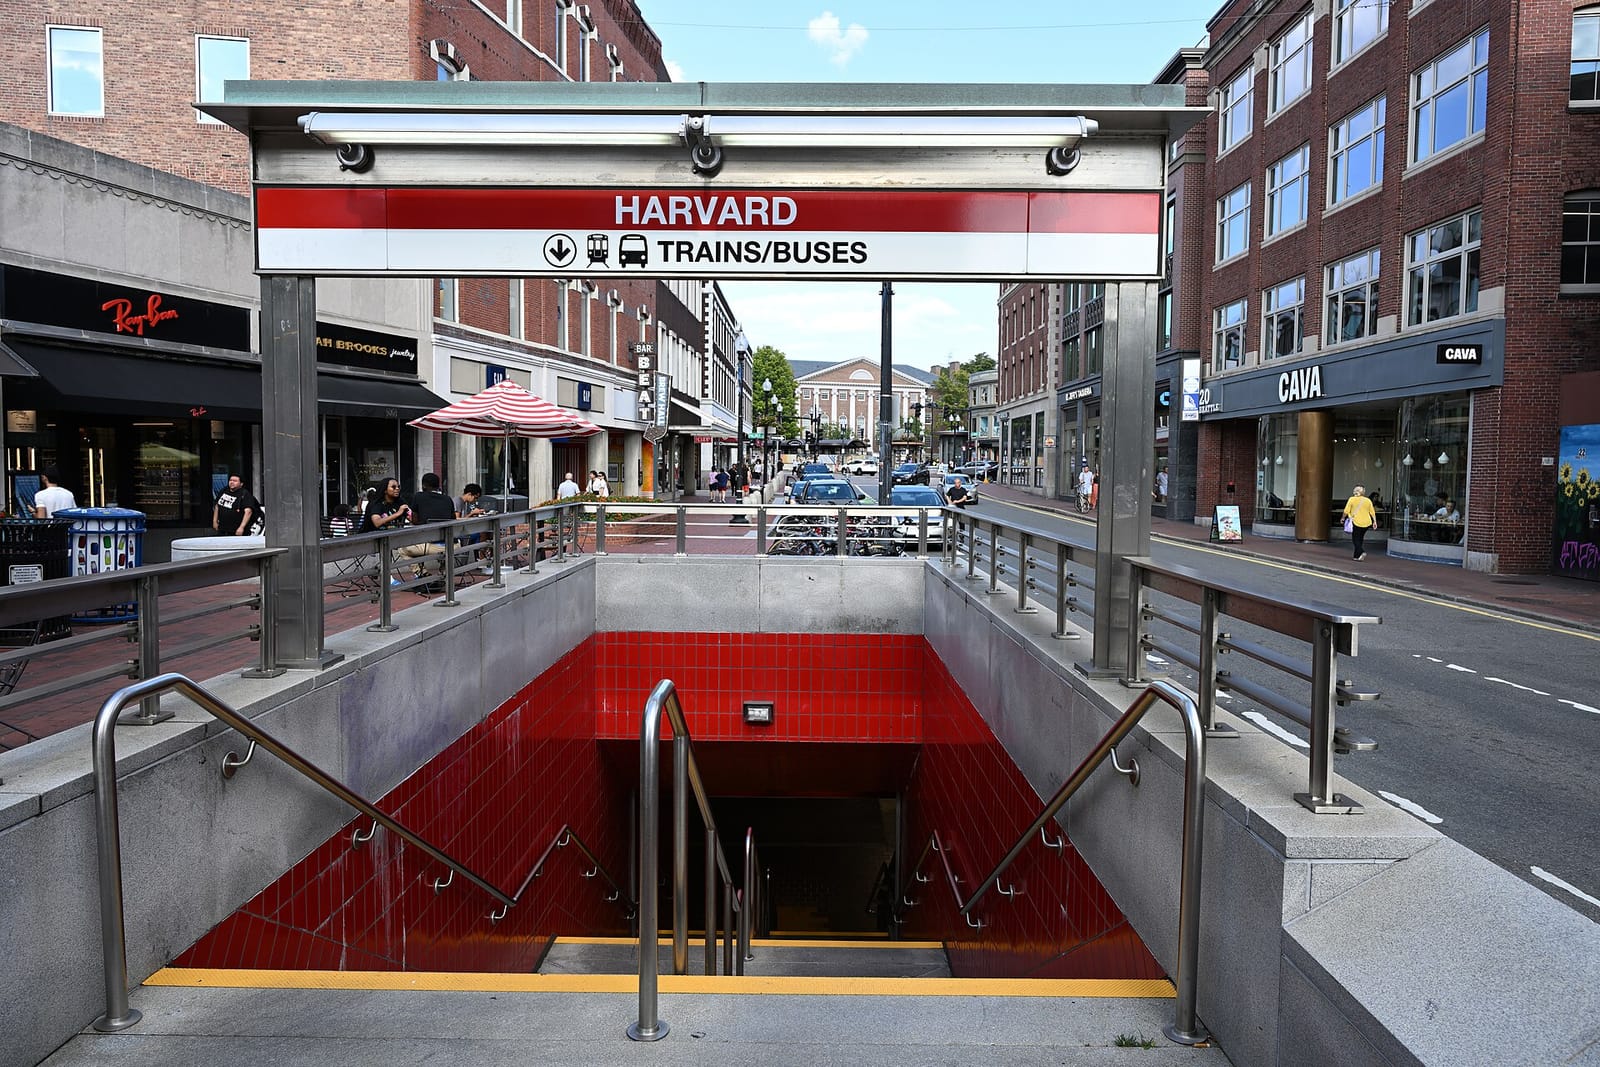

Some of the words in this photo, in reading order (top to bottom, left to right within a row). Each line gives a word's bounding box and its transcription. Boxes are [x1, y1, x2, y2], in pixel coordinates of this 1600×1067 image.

[614, 195, 798, 226] HARVARD
[657, 240, 868, 265] TRAINS/BUSES
[102, 294, 179, 335] Ray-Ban
[336, 339, 388, 356] BROOKS
[389, 348, 415, 361] jewelry
[636, 344, 652, 353] BAR
[1445, 348, 1477, 360] CAVA
[638, 356, 652, 420] BEAT
[1199, 388, 1210, 405] 20
[1278, 365, 1322, 403] CAVA
